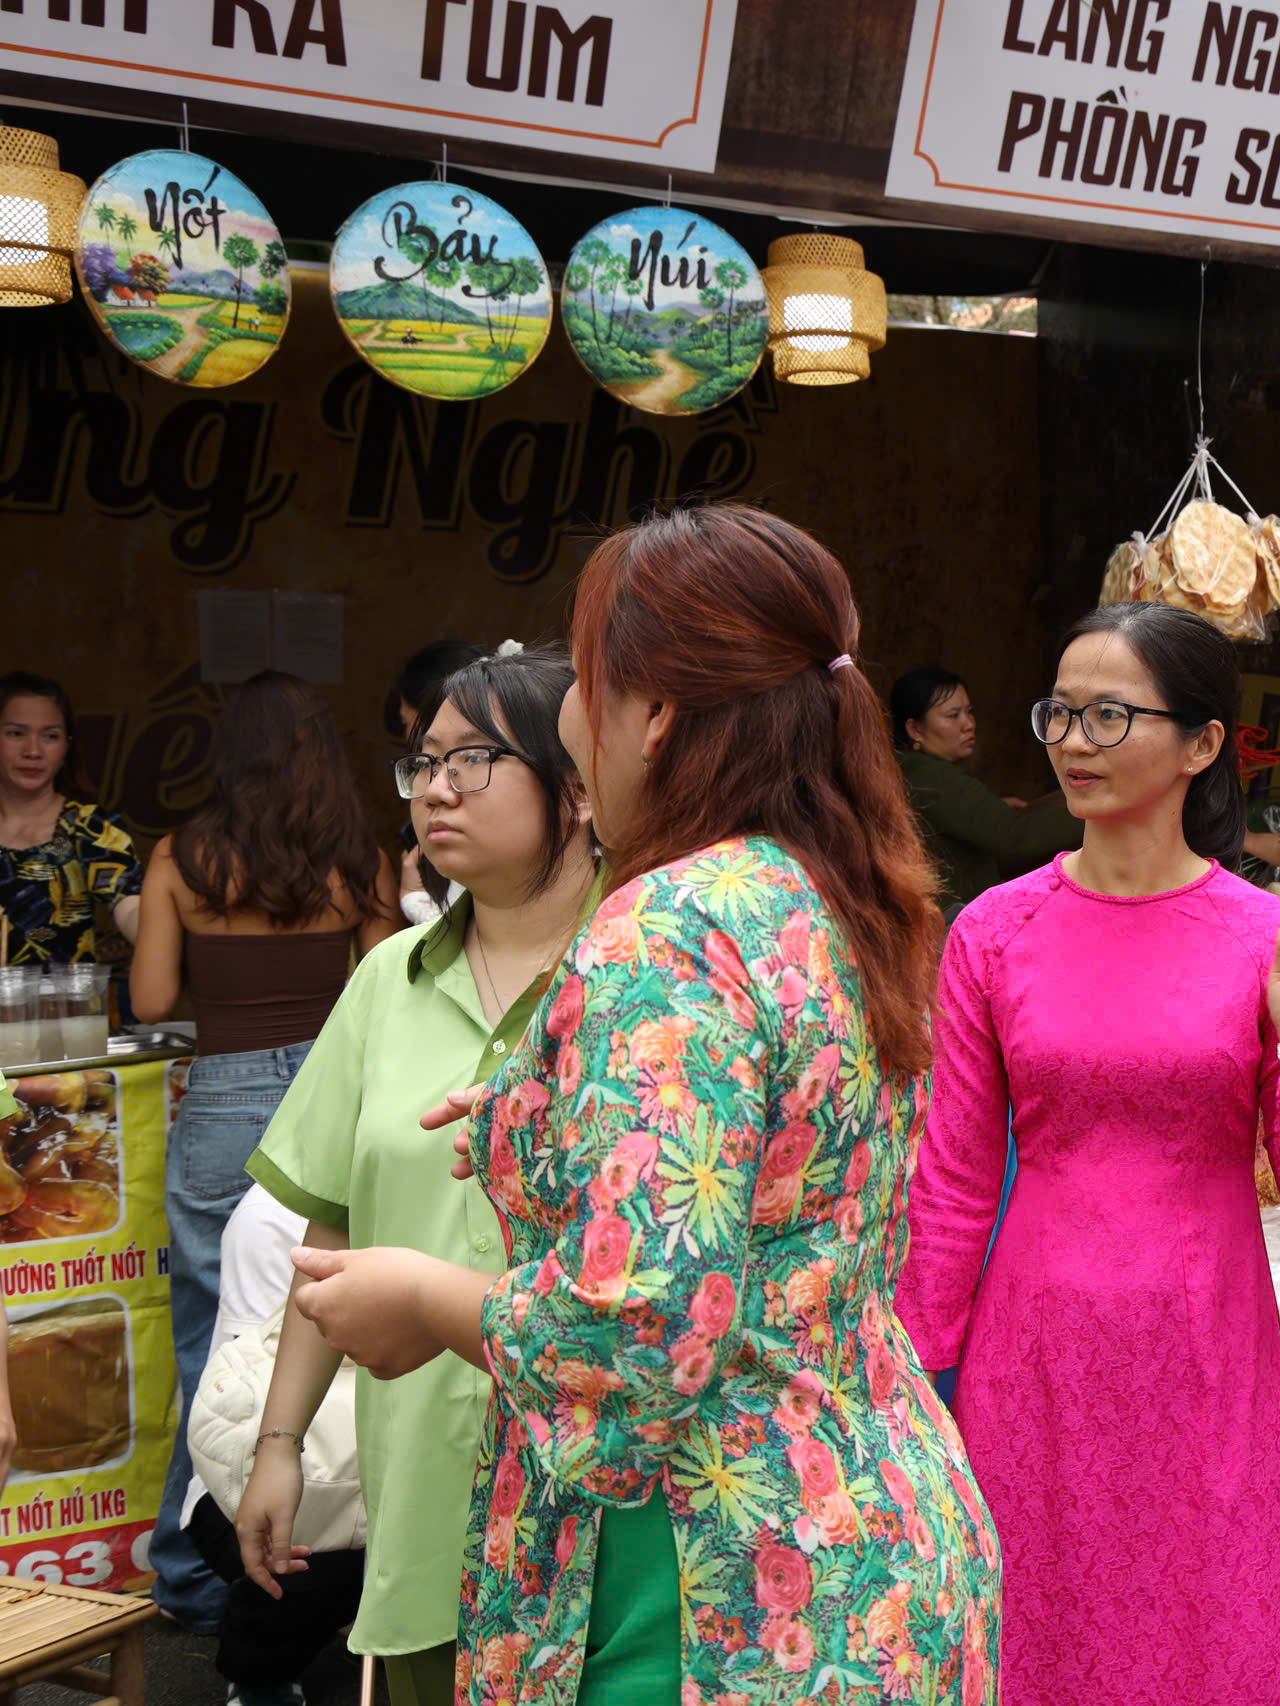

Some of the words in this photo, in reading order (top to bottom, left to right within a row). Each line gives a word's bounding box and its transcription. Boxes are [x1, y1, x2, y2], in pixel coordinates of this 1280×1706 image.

[997, 85, 1207, 197] PHỒNG
[374, 195, 516, 298] Bảy
[629, 221, 711, 311] Núi
[0, 1259, 56, 1297] ƯỜNG
[61, 1246, 105, 1288] THỐT
[111, 1241, 146, 1281] NỐT
[17, 1491, 54, 1534] NỐT
[60, 1486, 84, 1527] HỦ
[90, 1487, 126, 1521] 1KG
